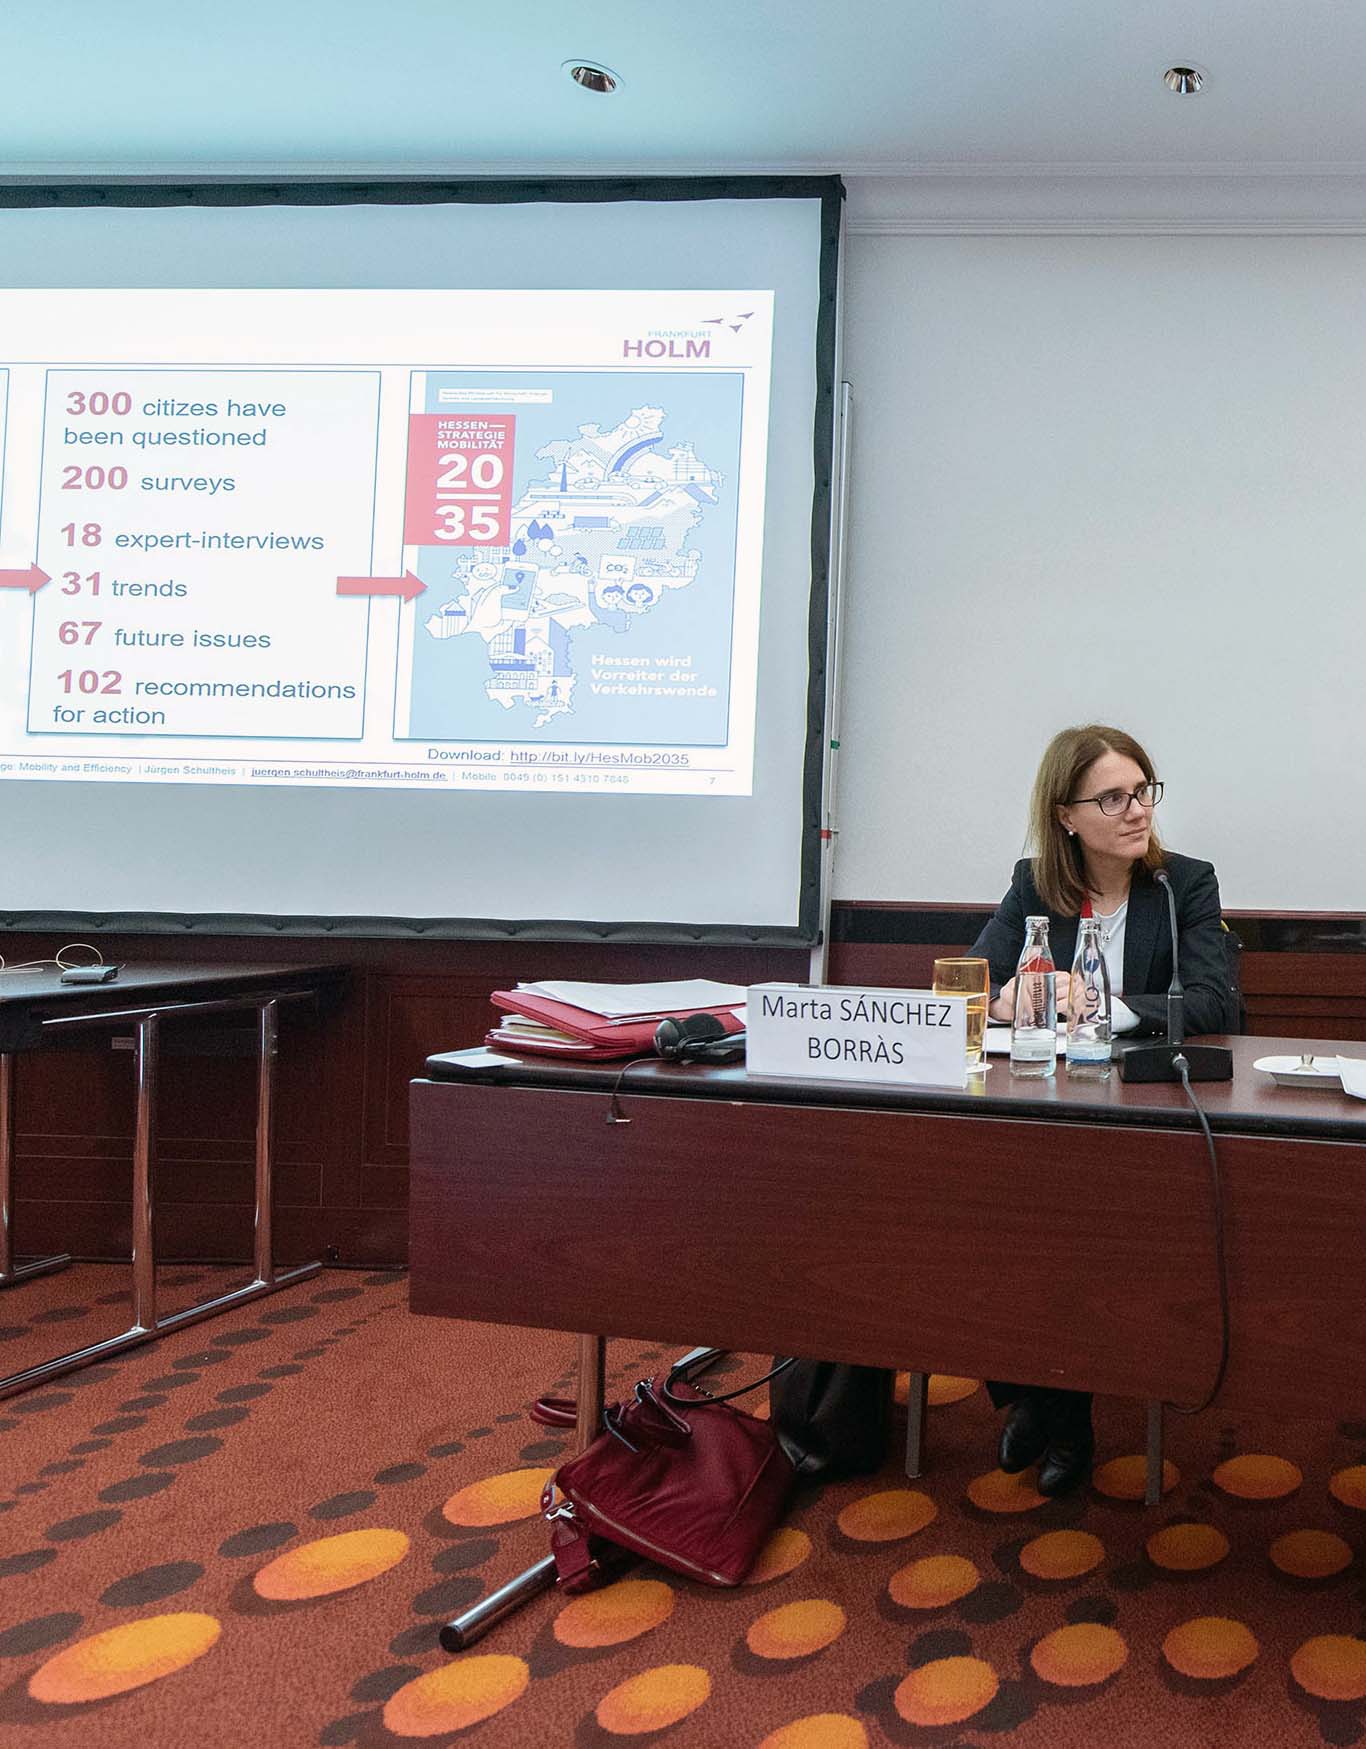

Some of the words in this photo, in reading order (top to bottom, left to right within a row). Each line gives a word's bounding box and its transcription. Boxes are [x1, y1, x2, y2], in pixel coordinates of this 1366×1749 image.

[623, 340, 711, 358] HOLM
[66, 391, 132, 415] 300
[142, 398, 218, 417] citizes
[227, 399, 286, 417] have
[64, 427, 124, 445] been
[132, 428, 267, 449] questioned
[437, 431, 505, 440] STRATEGIE
[437, 440, 504, 449] MOBILITÄT
[61, 466, 128, 490] 200
[140, 475, 236, 495] surveys
[436, 453, 504, 489] 20
[434, 505, 500, 541] 35
[60, 522, 102, 547] 18
[115, 531, 325, 551] expert-interviews
[61, 572, 101, 596] 31
[112, 579, 188, 598] trends
[58, 621, 103, 645] 67
[114, 628, 184, 647] future
[193, 629, 271, 649] issues
[592, 655, 650, 666] Hessen
[656, 655, 692, 667] wird
[57, 669, 123, 695] 102
[135, 680, 356, 699] recommendations
[670, 670, 698, 682] der
[53, 704, 86, 723] for
[93, 706, 165, 725] action
[19, 762, 58, 774] Mobility
[61, 764, 80, 772] and
[83, 764, 133, 775] Efficiency
[182, 766, 236, 776] Schultheis
[762, 995, 832, 1022] Marta
[840, 994, 952, 1028] SÁNCHEZ
[808, 1034, 904, 1065] BORRÀS
